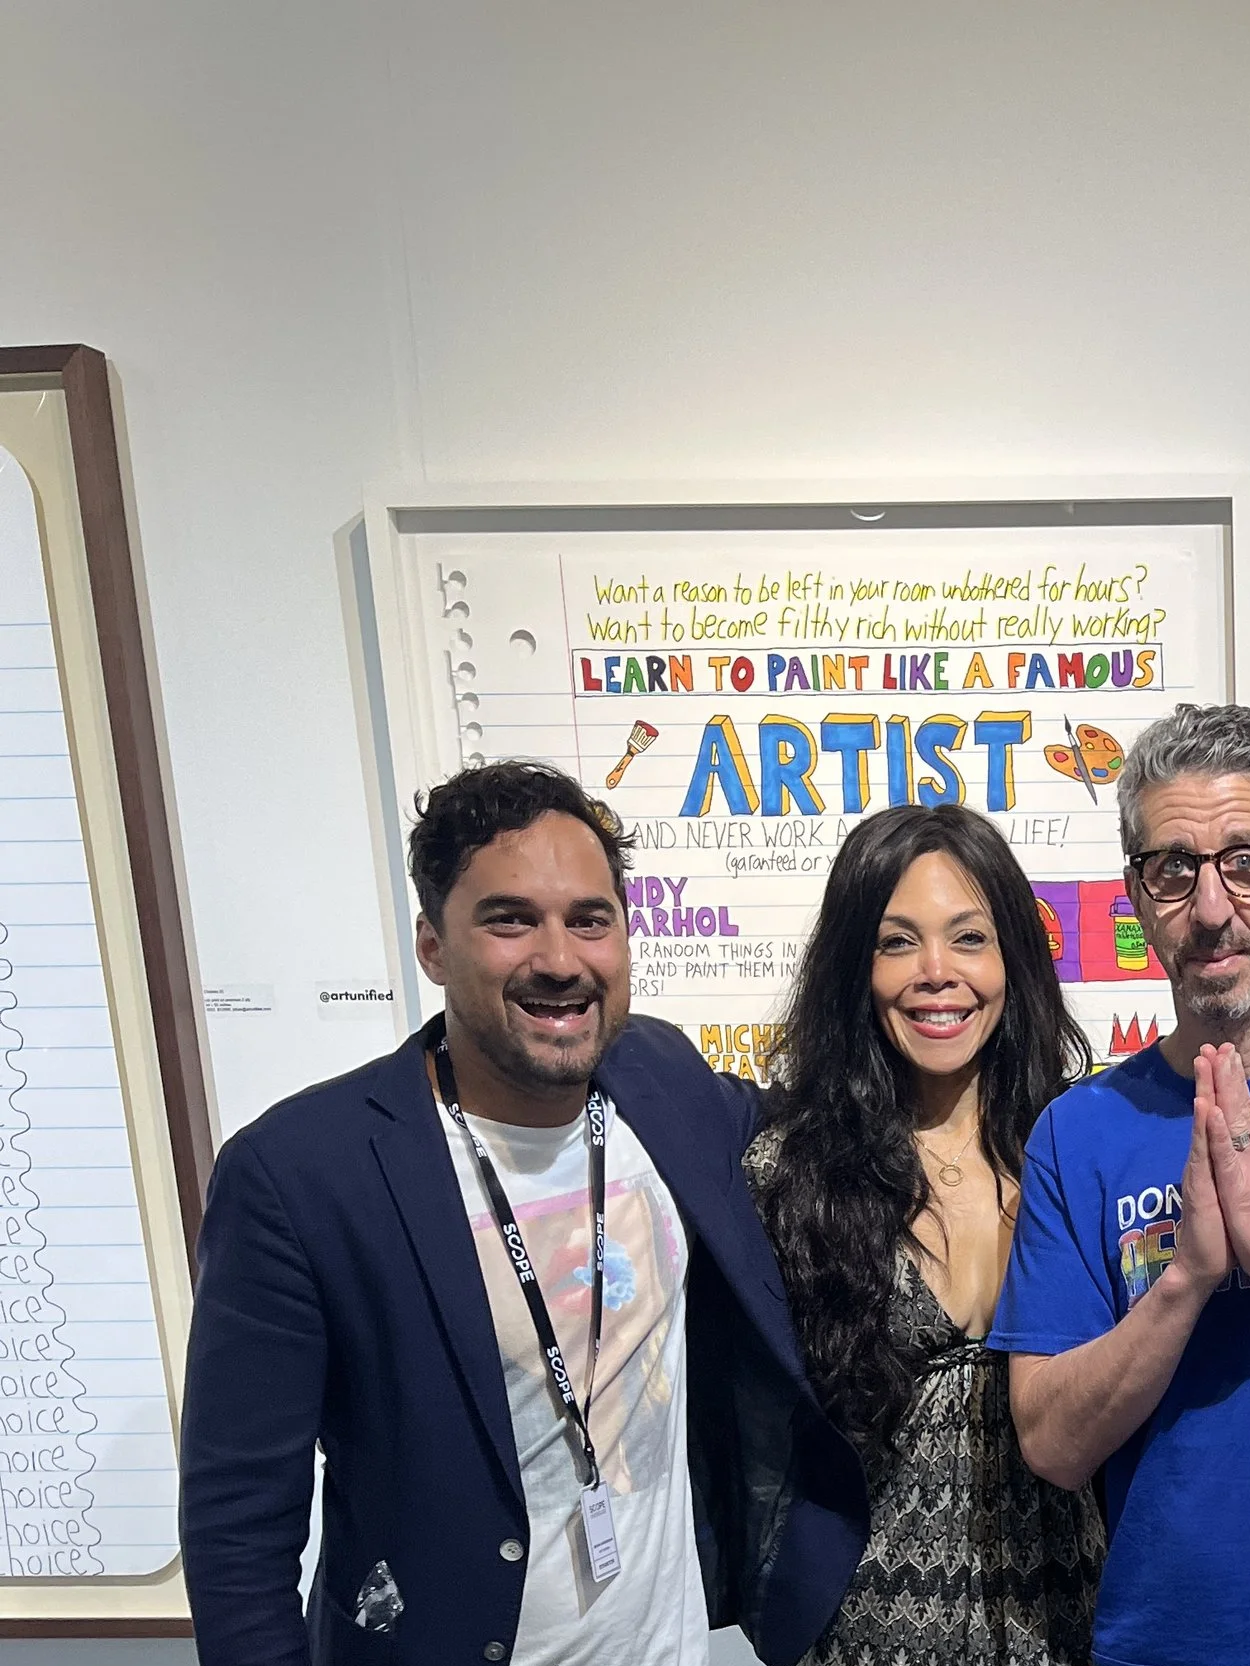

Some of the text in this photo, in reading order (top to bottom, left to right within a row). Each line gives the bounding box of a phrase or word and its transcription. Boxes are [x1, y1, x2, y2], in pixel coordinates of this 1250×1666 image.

[594, 562, 1148, 606] Want a reason to be left in your room unbothered for hours?
[587, 602, 1167, 646] Want to become filthy rich without really working?
[580, 649, 1156, 693] LEARN TO PAINT LIKE A FAMOUS
[678, 710, 1032, 817] ARTIST
[635, 820, 677, 850] AND
[687, 821, 754, 850] NEVER
[761, 819, 825, 849] WORK
[1009, 815, 1070, 848] LIFE!
[725, 850, 796, 879] (garanteed
[801, 856, 820, 871] or
[625, 876, 688, 908] NDY
[628, 906, 739, 937] ARHOL
[639, 942, 797, 959] RANDOM THINGS IN
[646, 961, 677, 977] AND
[685, 961, 729, 978] PAINT
[736, 961, 775, 978] THEM
[780, 961, 796, 978] IN
[319, 989, 394, 1002] @artunified
[588, 1091, 604, 1147] SCOPE
[503, 1223, 535, 1284] SCOPE
[546, 1346, 575, 1405] SCOPE
